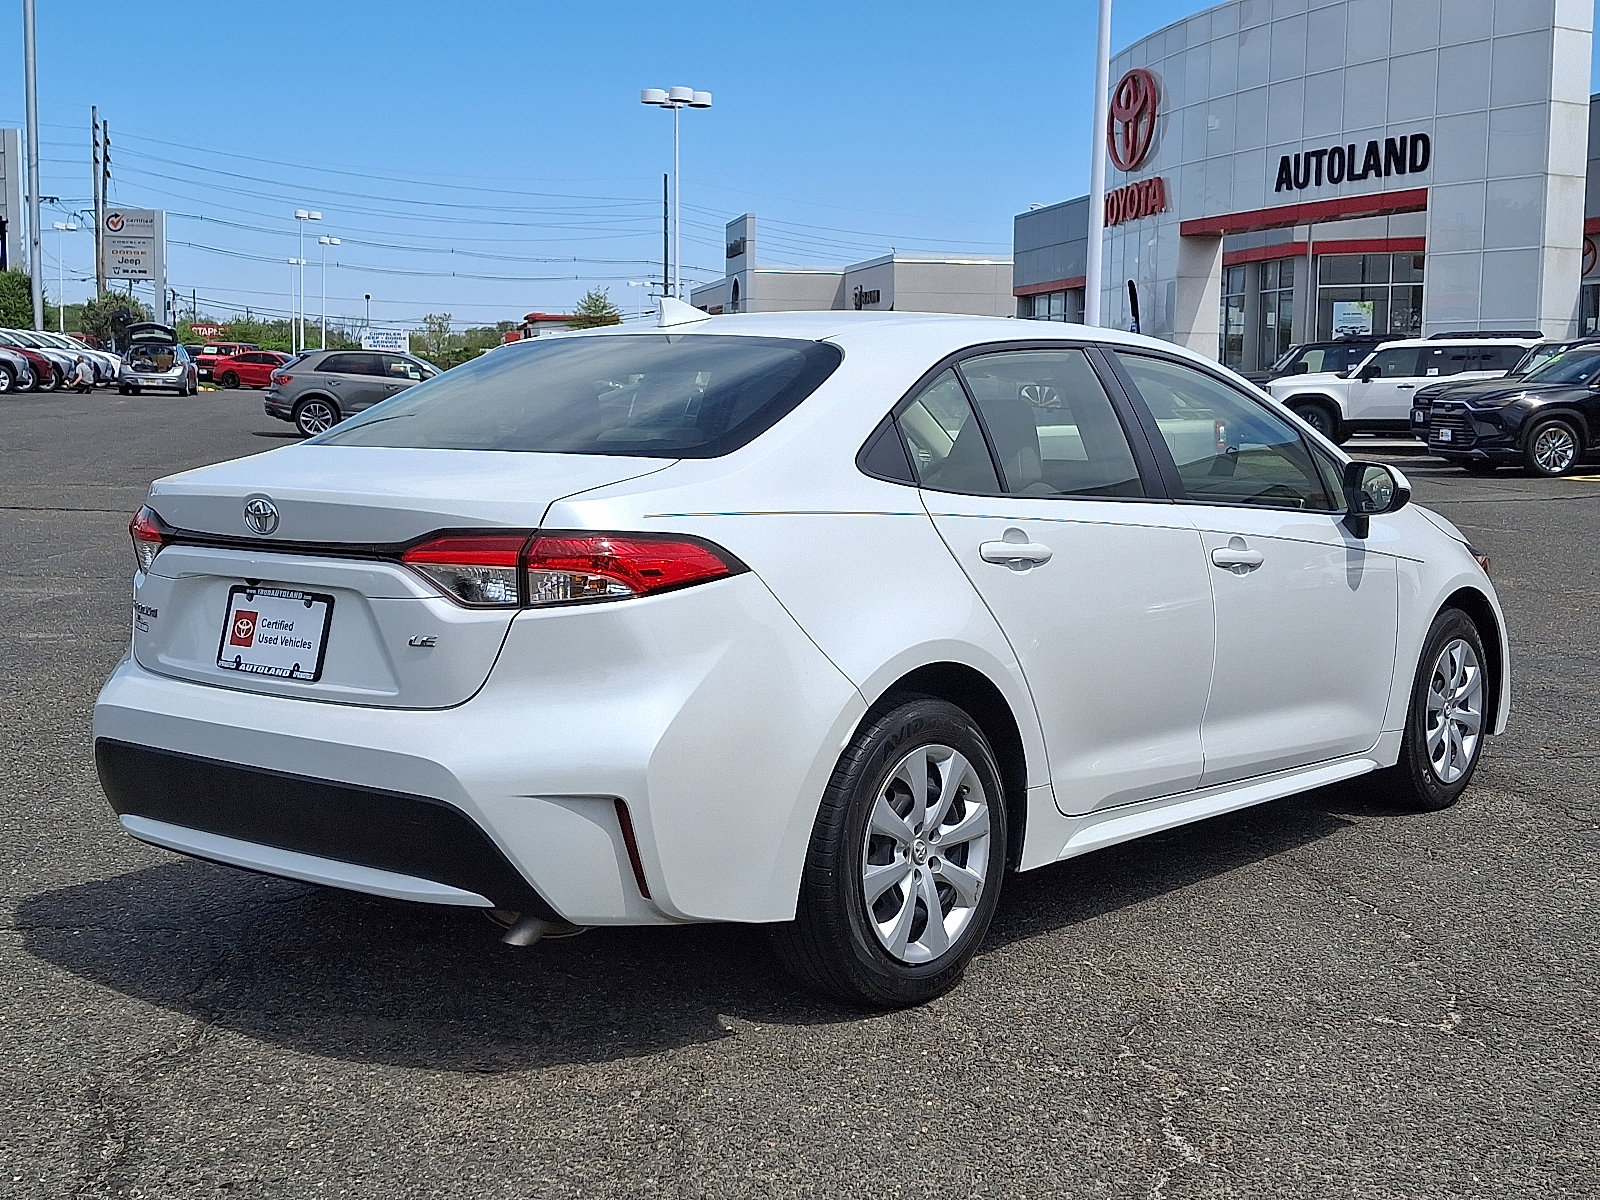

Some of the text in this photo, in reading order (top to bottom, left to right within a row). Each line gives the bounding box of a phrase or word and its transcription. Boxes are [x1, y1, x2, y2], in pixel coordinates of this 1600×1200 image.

[1274, 133, 1431, 192] AUTOLAND
[117, 256, 141, 265] Jeep
[191, 326, 229, 337] STAPE
[261, 618, 295, 632] Certified
[258, 632, 313, 650] Used Vehicles
[408, 634, 439, 648] LE
[238, 662, 291, 678] AUTOLAND
